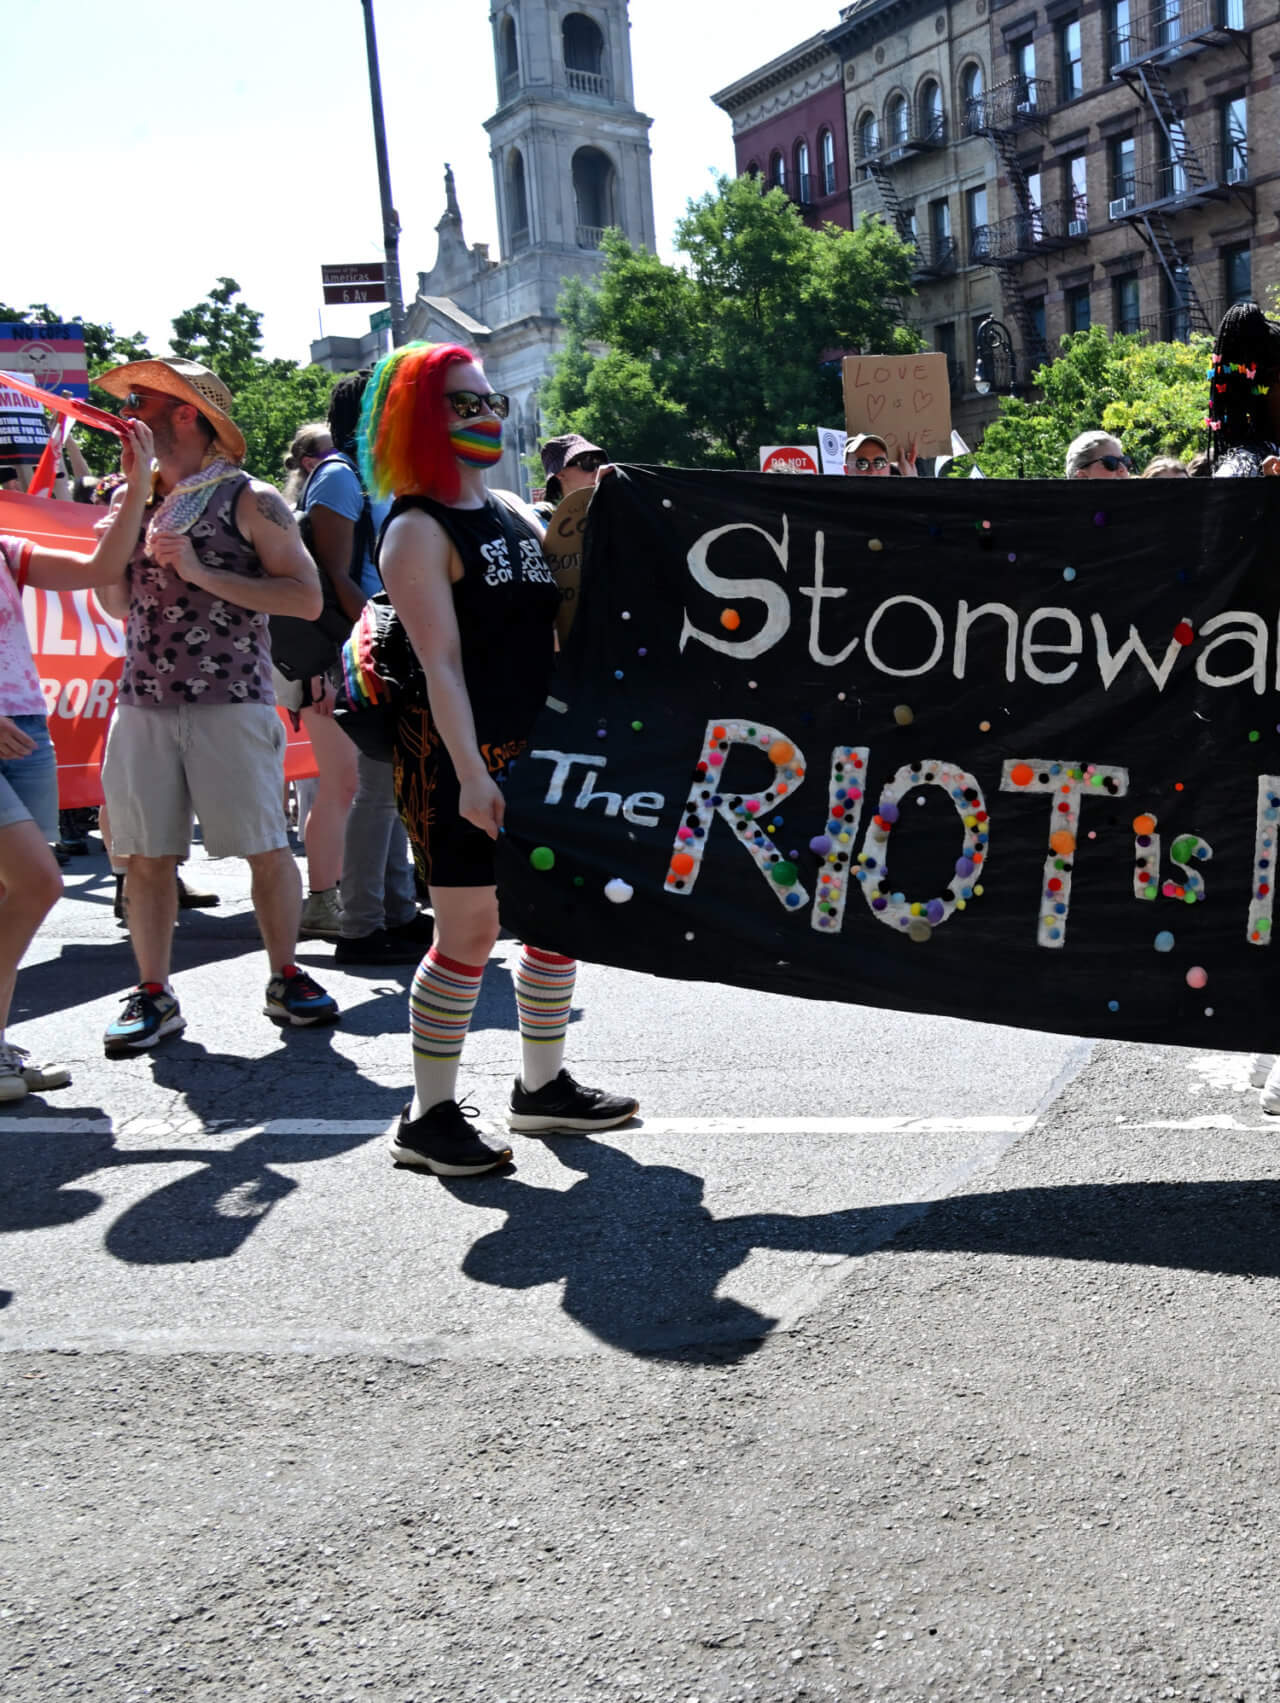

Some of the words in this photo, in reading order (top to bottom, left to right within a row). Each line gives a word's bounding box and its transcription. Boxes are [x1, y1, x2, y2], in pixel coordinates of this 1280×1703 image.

[343, 289, 350, 302] 6
[354, 289, 367, 302] Av
[12, 326, 33, 341] NO
[855, 362, 928, 388] LOVE
[883, 429, 937, 448] OVE
[531, 750, 664, 828] The
[664, 718, 1129, 949] RIOT
[1133, 812, 1214, 904] is
